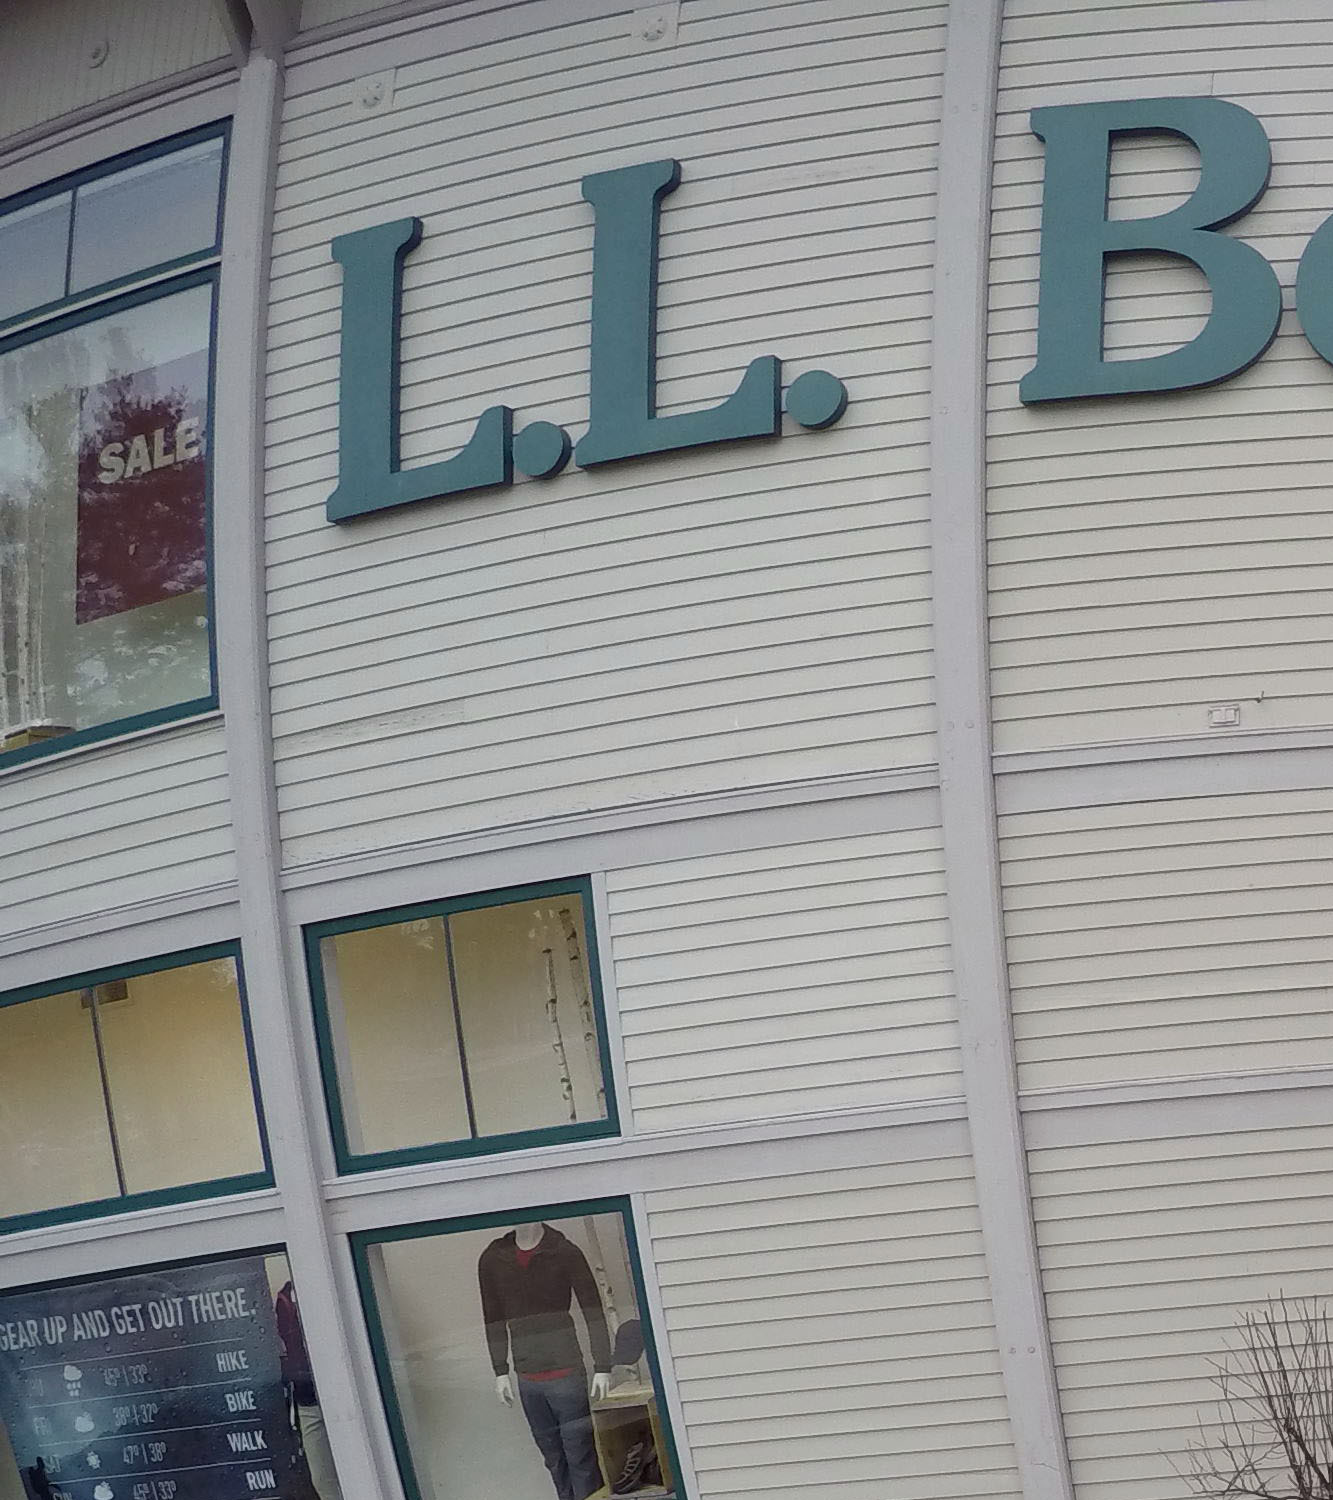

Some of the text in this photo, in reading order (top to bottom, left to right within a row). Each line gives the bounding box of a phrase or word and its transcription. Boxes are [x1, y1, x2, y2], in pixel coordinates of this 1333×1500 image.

[327, 157, 849, 525] L.L.
[99, 416, 201, 486] SALE
[0, 1287, 257, 1352] GEAR UP AND GET OUT THERE.
[216, 1350, 249, 1373] HIKE
[224, 1390, 257, 1413] BIKE
[227, 1430, 268, 1453] WALK
[246, 1469, 276, 1491] RUN
